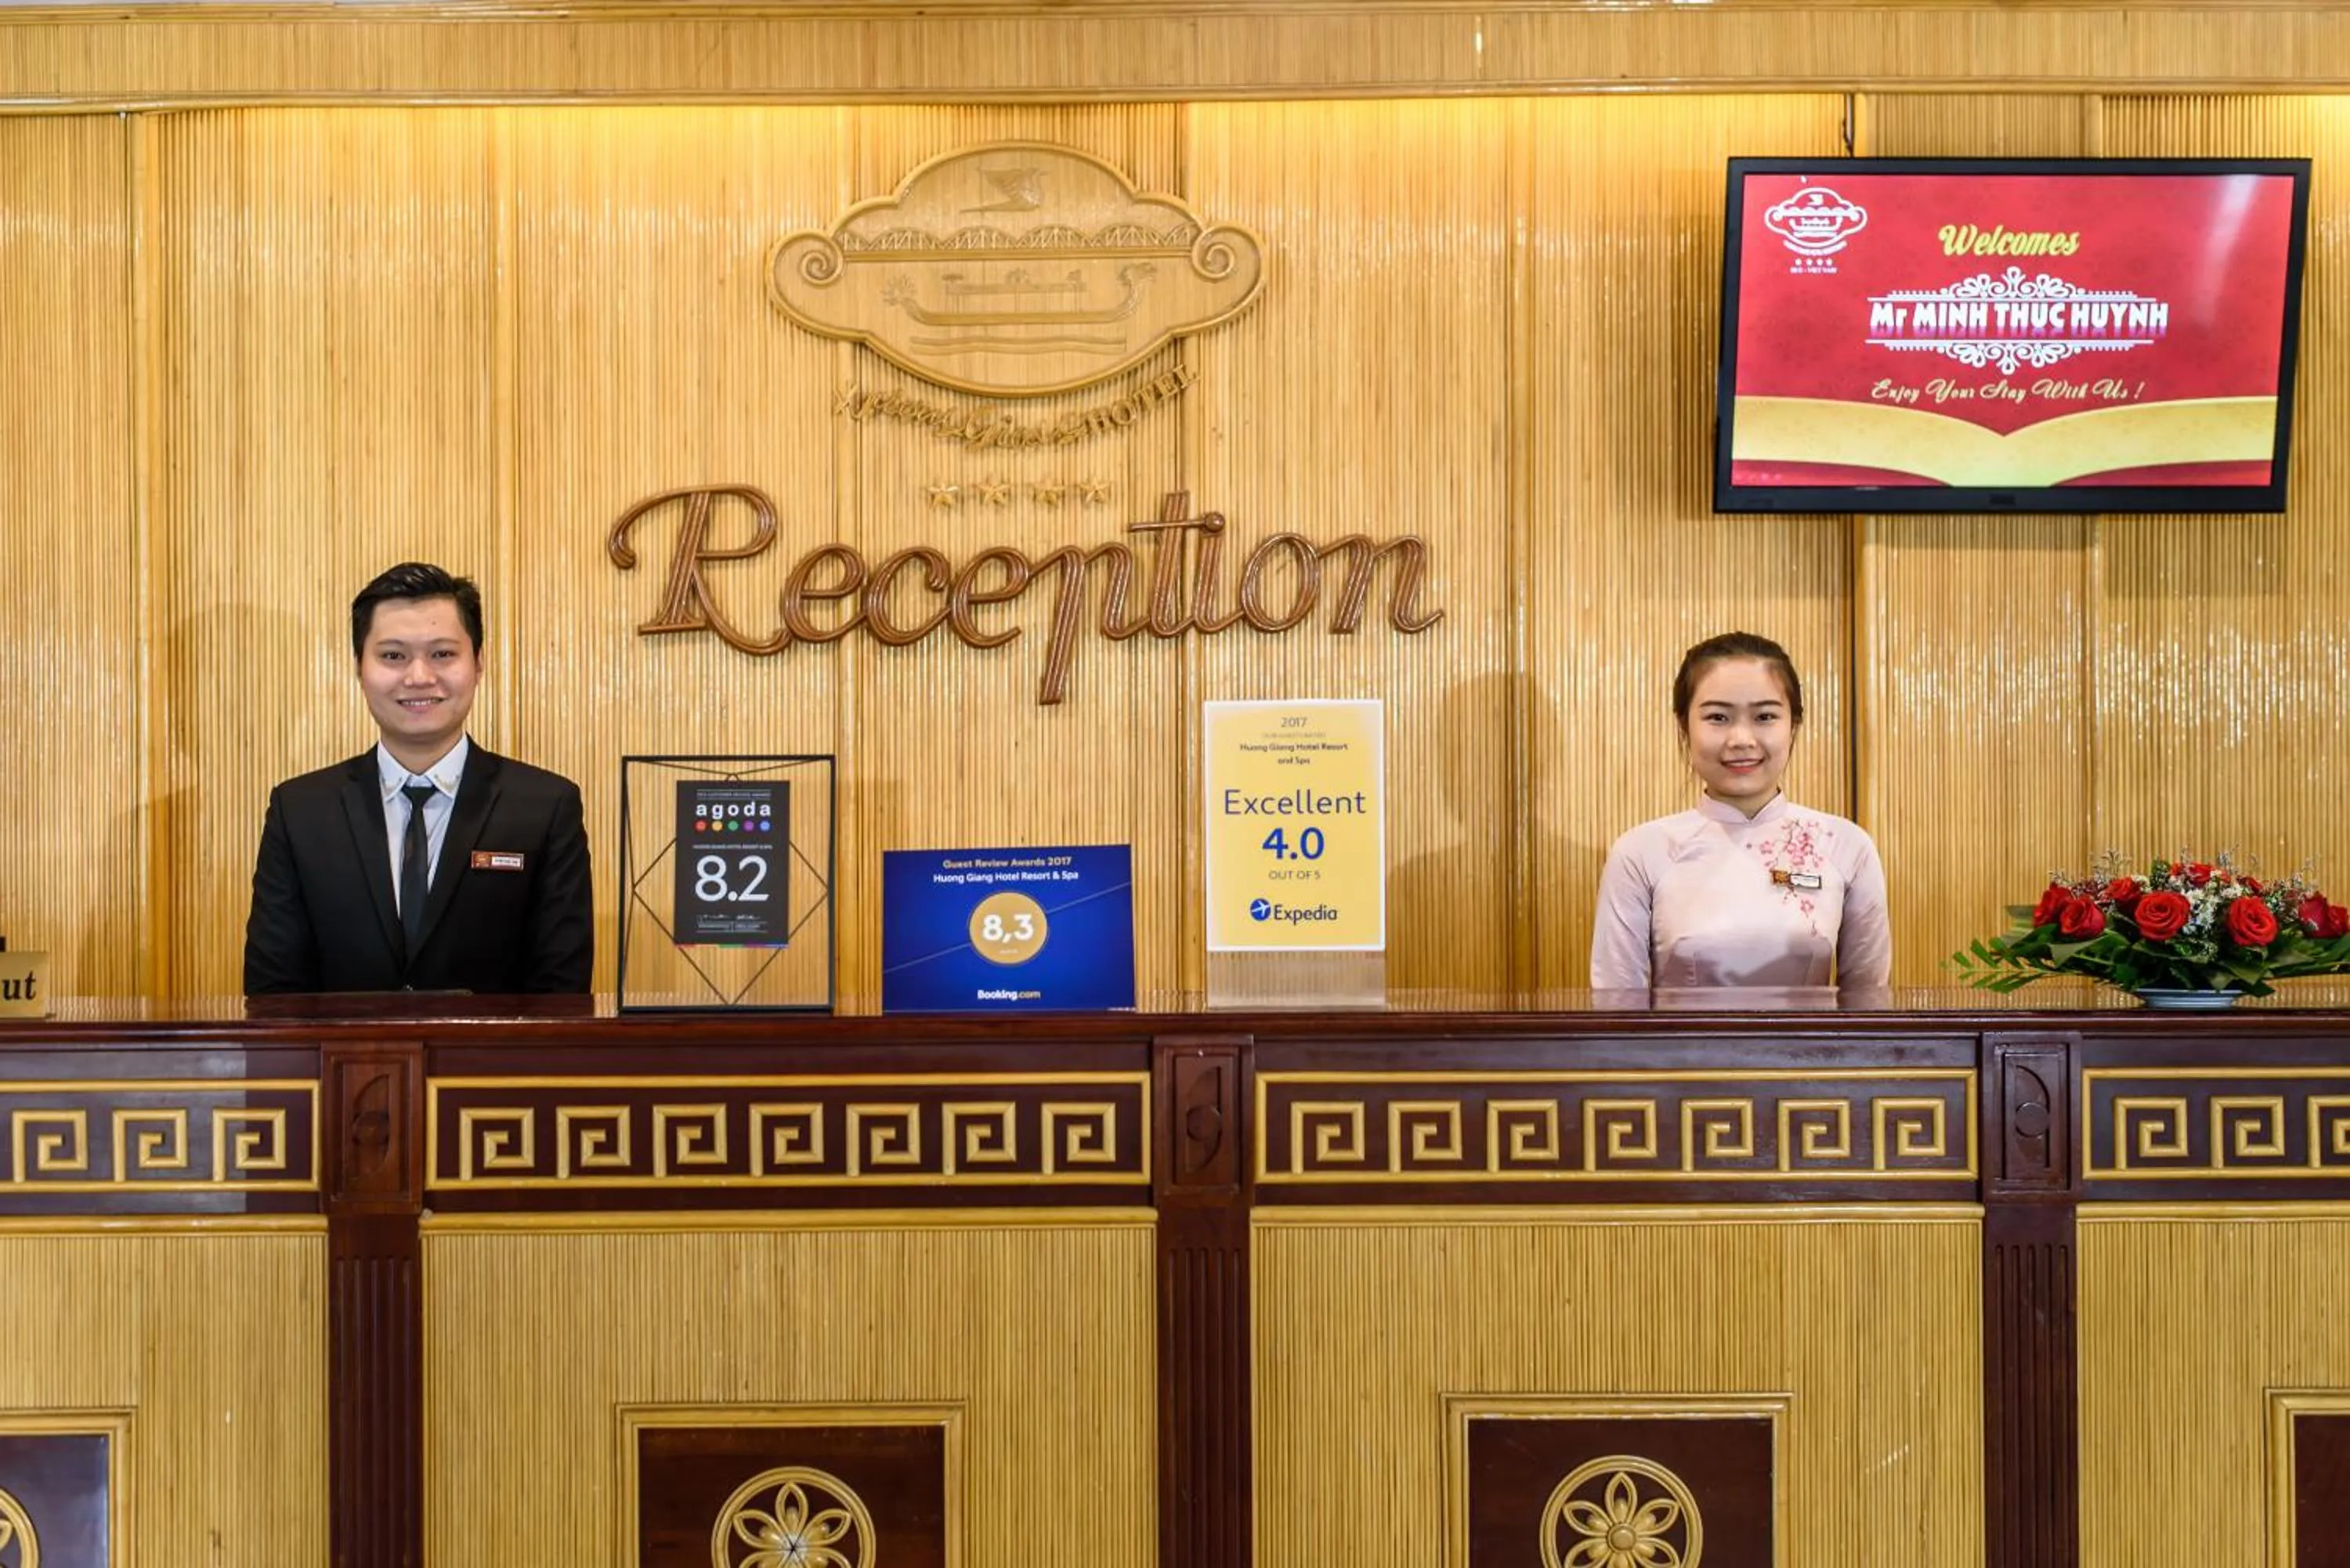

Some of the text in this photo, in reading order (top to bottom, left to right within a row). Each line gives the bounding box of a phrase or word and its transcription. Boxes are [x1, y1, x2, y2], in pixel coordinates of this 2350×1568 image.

[1938, 224, 2080, 257] Welcomes
[1870, 302, 2169, 327] Mr MINH THUC HUYNH
[1084, 363, 1201, 433] HOTEL
[1871, 378, 1919, 403] Enjoy
[1925, 378, 1976, 403] Your
[1979, 379, 2027, 403] Stay
[2031, 379, 2087, 399] With
[2092, 379, 2129, 399] Us
[607, 483, 1445, 706] Reception
[1281, 717, 1307, 728] 2017
[1278, 756, 1311, 765] and Spa
[696, 801, 772, 820] agoda
[1224, 789, 1367, 815] Excellent
[1262, 826, 1325, 860] 4.0
[942, 856, 1072, 869] Guest Review Awards 2017
[1268, 870, 1321, 880] OUT OF 5
[695, 854, 769, 901] 8.2
[933, 870, 1079, 884] Huong Giang Hotel Resort & Spa
[1274, 904, 1338, 926] Expedia
[982, 914, 1034, 944] 8,3
[1, 970, 37, 1000] ut
[977, 989, 1041, 1001] Booking.com
